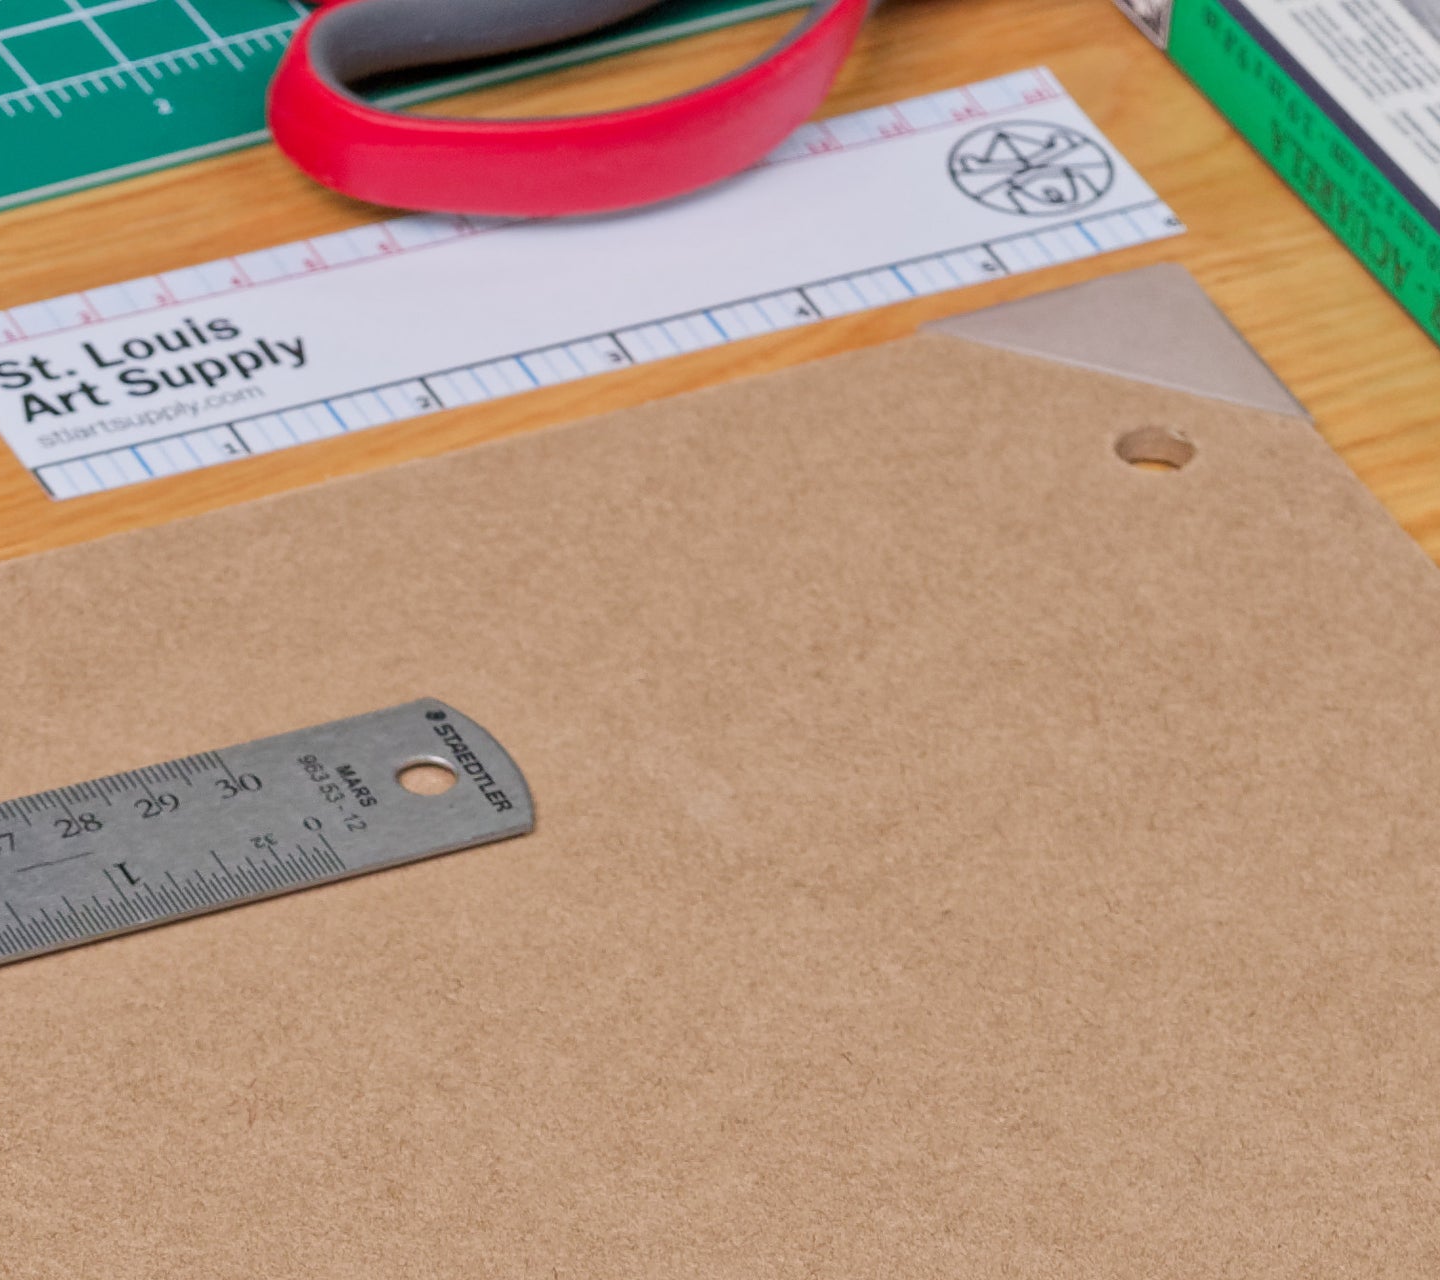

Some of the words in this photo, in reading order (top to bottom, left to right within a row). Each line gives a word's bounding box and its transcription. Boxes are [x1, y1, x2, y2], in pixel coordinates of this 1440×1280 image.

[1271, 119, 1410, 288] ACUARELA
[82, 315, 241, 368] Louis
[21, 381, 110, 423] Art
[120, 336, 308, 400] Supply
[37, 384, 265, 450] stlartsupply.com
[336, 763, 377, 808] MARS
[433, 722, 513, 813] STAEDTLER
[53, 810, 104, 839] 28
[134, 791, 180, 819] 29
[214, 772, 264, 800] 30
[302, 816, 322, 833] 0
[115, 861, 141, 888] 1
